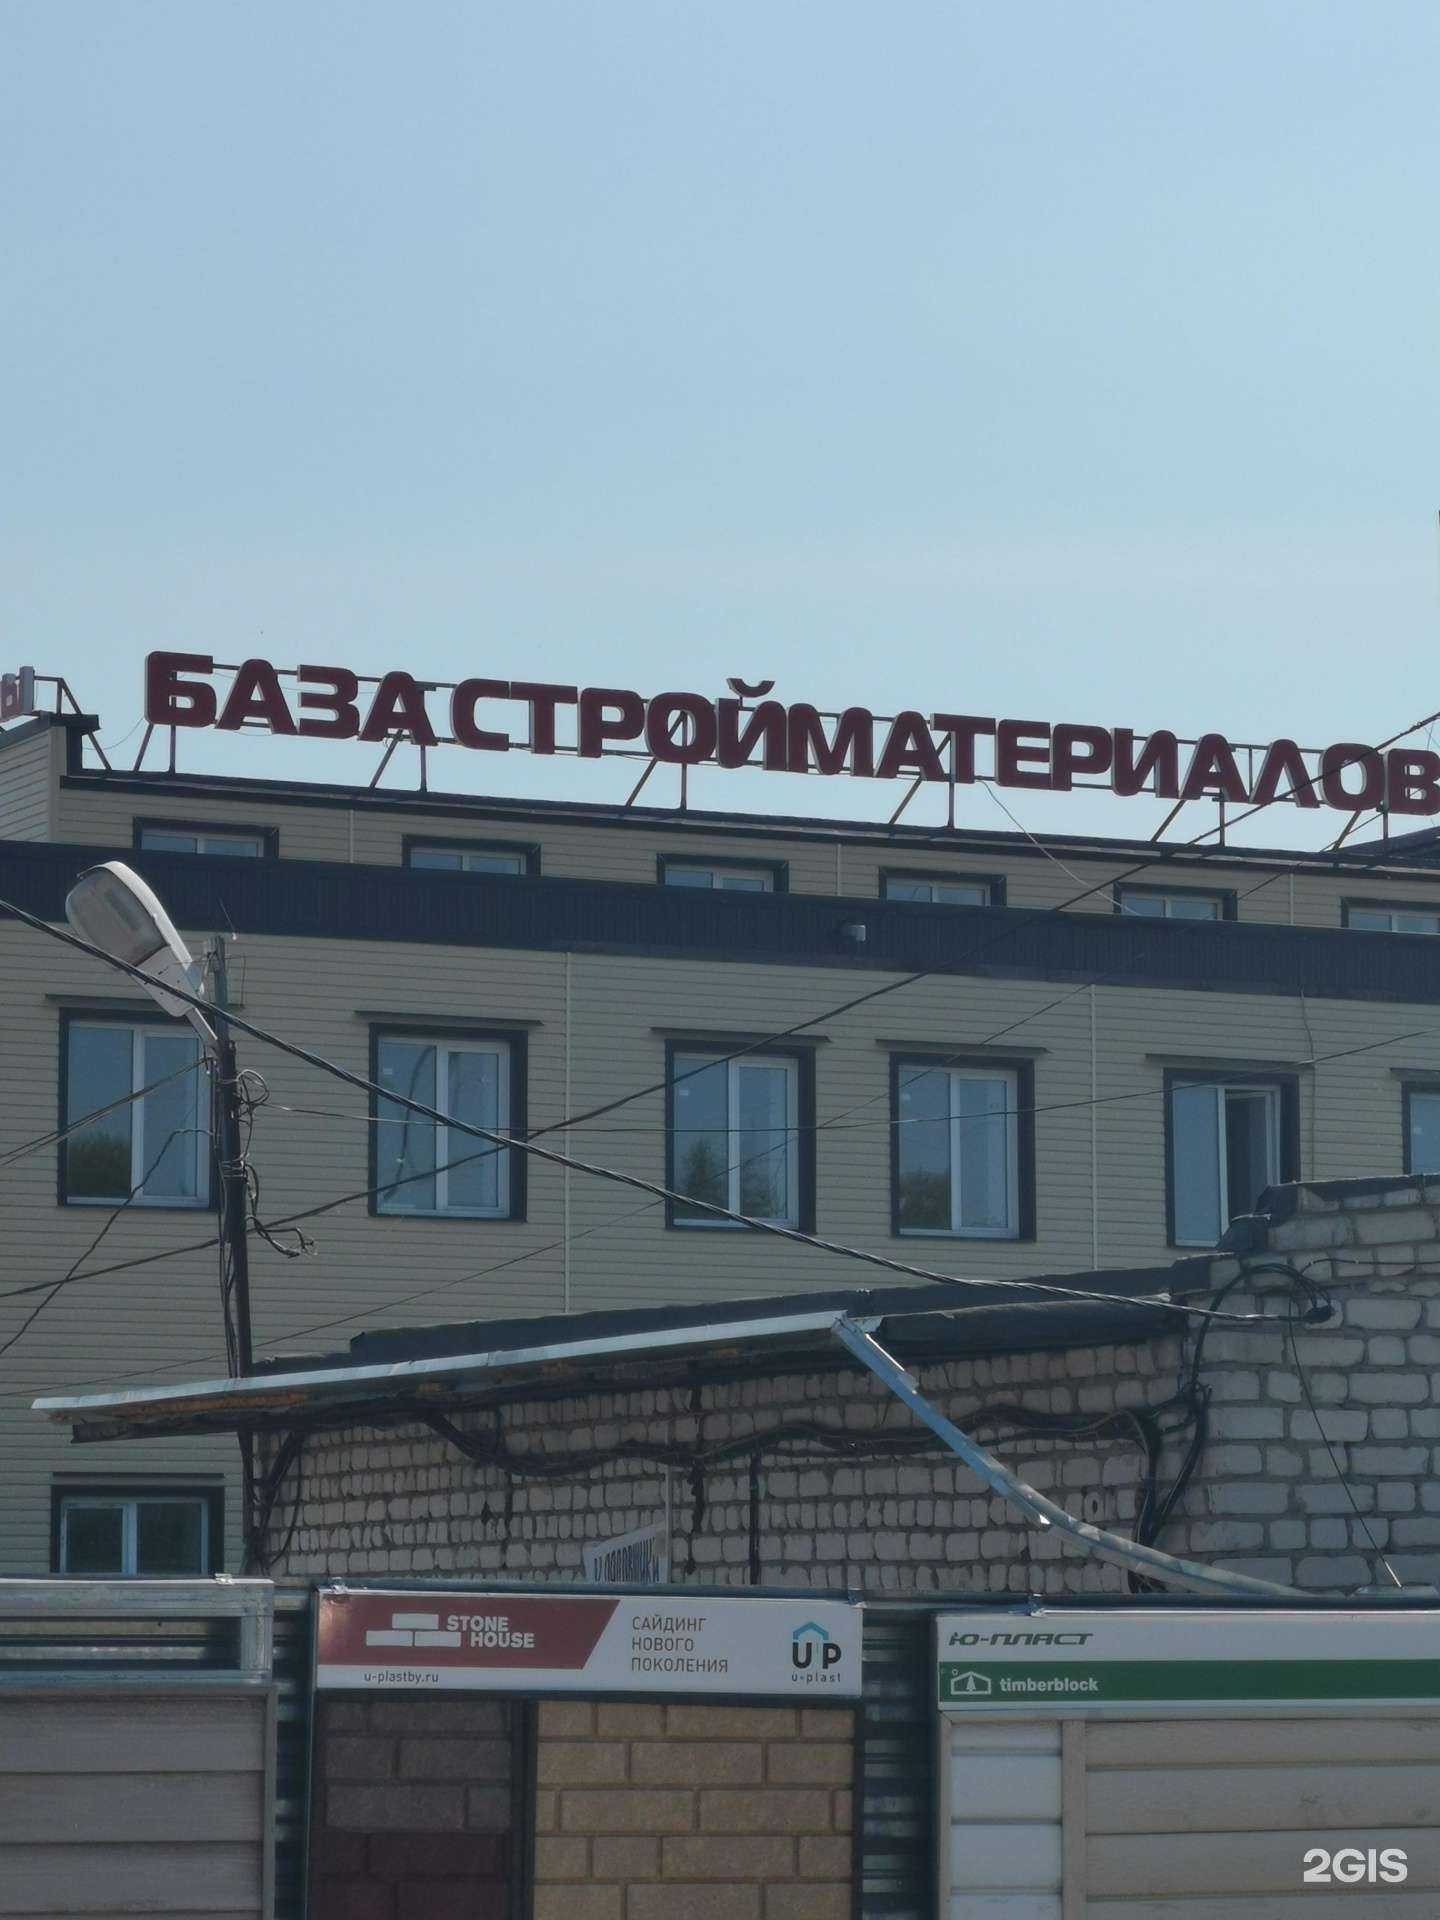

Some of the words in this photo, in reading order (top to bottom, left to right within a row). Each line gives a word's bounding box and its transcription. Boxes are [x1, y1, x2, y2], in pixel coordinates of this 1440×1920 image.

[446, 1615, 509, 1632] STONE
[632, 1614, 707, 1633] САЙДИНГ
[470, 1631, 535, 1648] HOUSE
[632, 1637, 694, 1652] НОВОГО
[792, 1642, 842, 1669] UP
[631, 1657, 728, 1673] ПОКОЛЕНИЯ
[364, 1671, 439, 1684] u-plastby.ru
[791, 1672, 841, 1683] u-plast
[1000, 1677, 1099, 1692] timberblock
